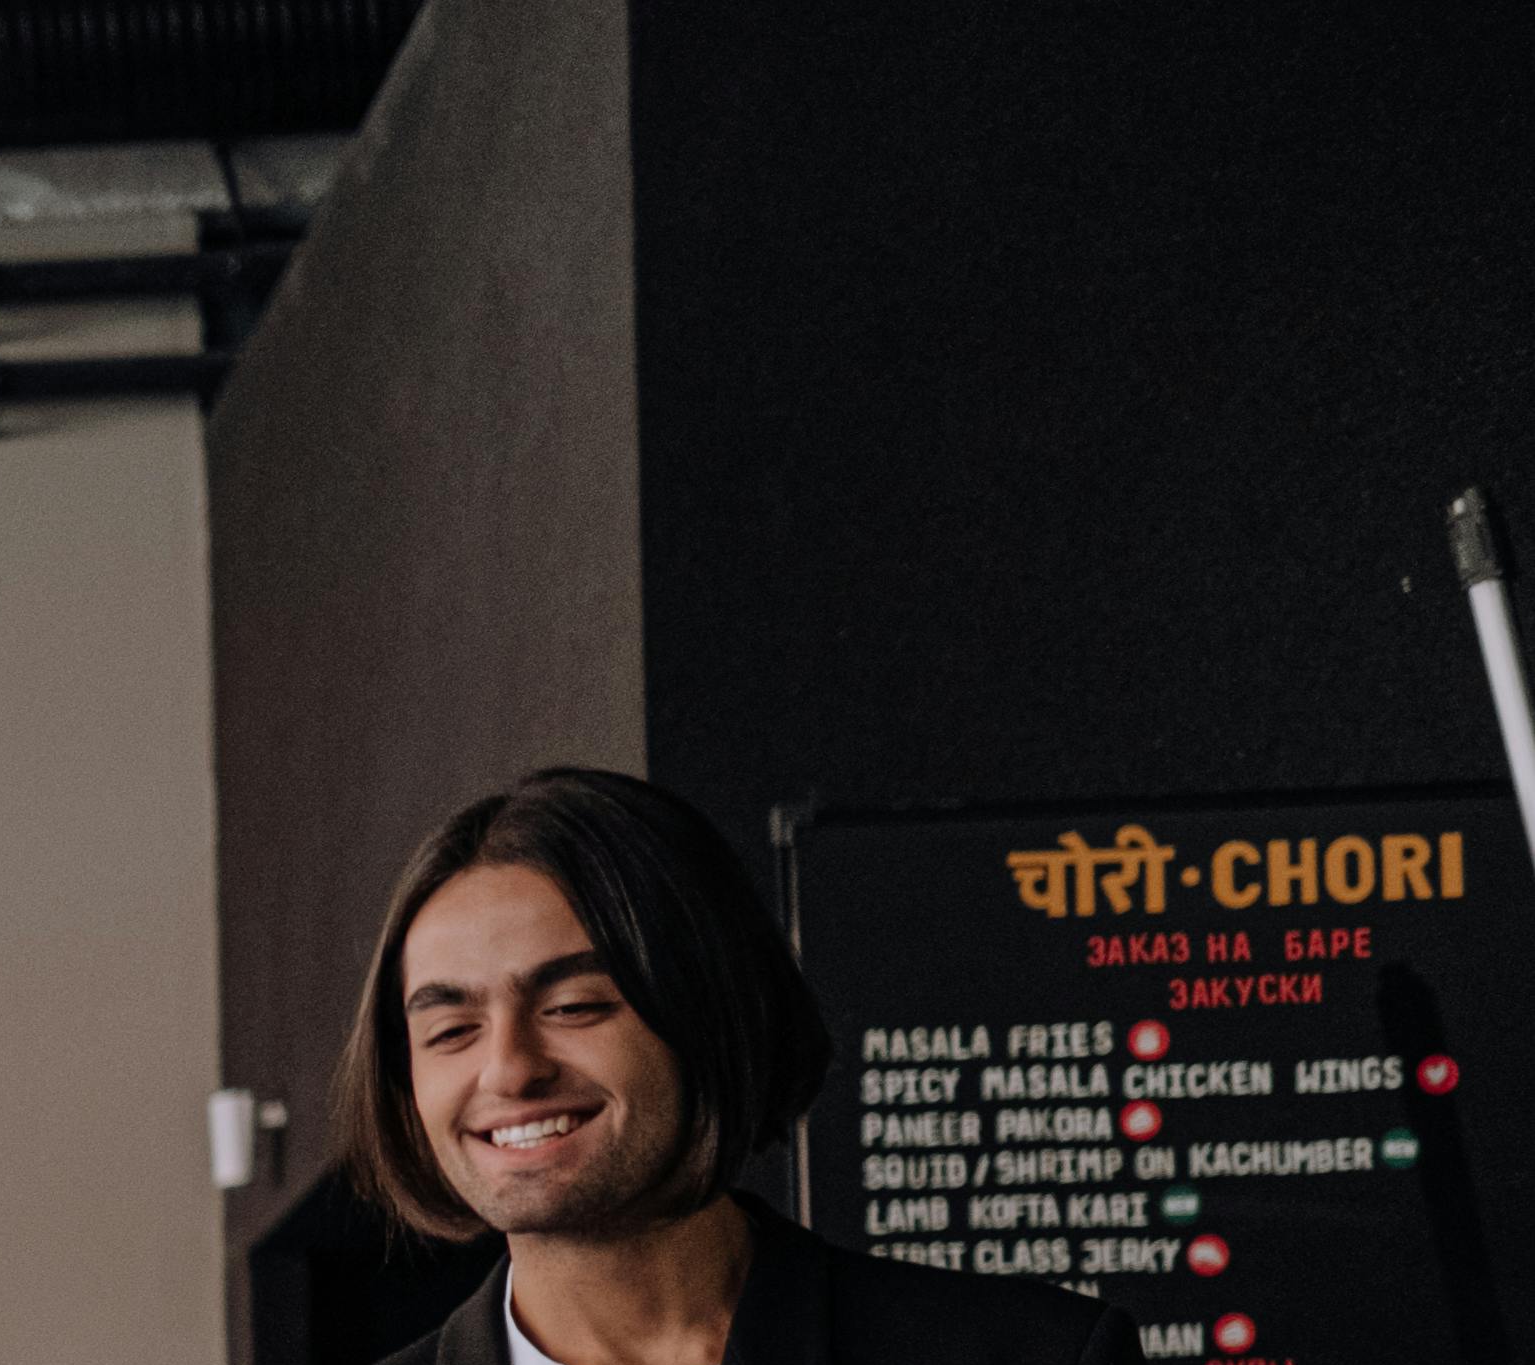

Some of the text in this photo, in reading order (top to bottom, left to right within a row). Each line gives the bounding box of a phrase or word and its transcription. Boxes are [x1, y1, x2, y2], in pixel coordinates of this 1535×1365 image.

[1212, 832, 1463, 908] CHORI
[1088, 928, 1370, 966] ЗАКАЗ НА БАРЕ
[1170, 974, 1322, 1009] ЗАКУСКИ
[864, 1022, 1113, 1061] MASALA FRIES
[862, 1057, 1402, 1104] SPICY MASALA CHICKEN WINGS
[862, 1108, 1112, 1146] PANEER PAKORA
[1135, 1147, 1175, 1179] ON
[1189, 1138, 1373, 1176] KACHUMBER
[867, 1197, 948, 1235] LAMB
[970, 1194, 1060, 1228] KOFTA
[1068, 1193, 1147, 1227] KARI
[974, 1238, 1071, 1274] CLASS
[1082, 1239, 1180, 1273] JERKY
